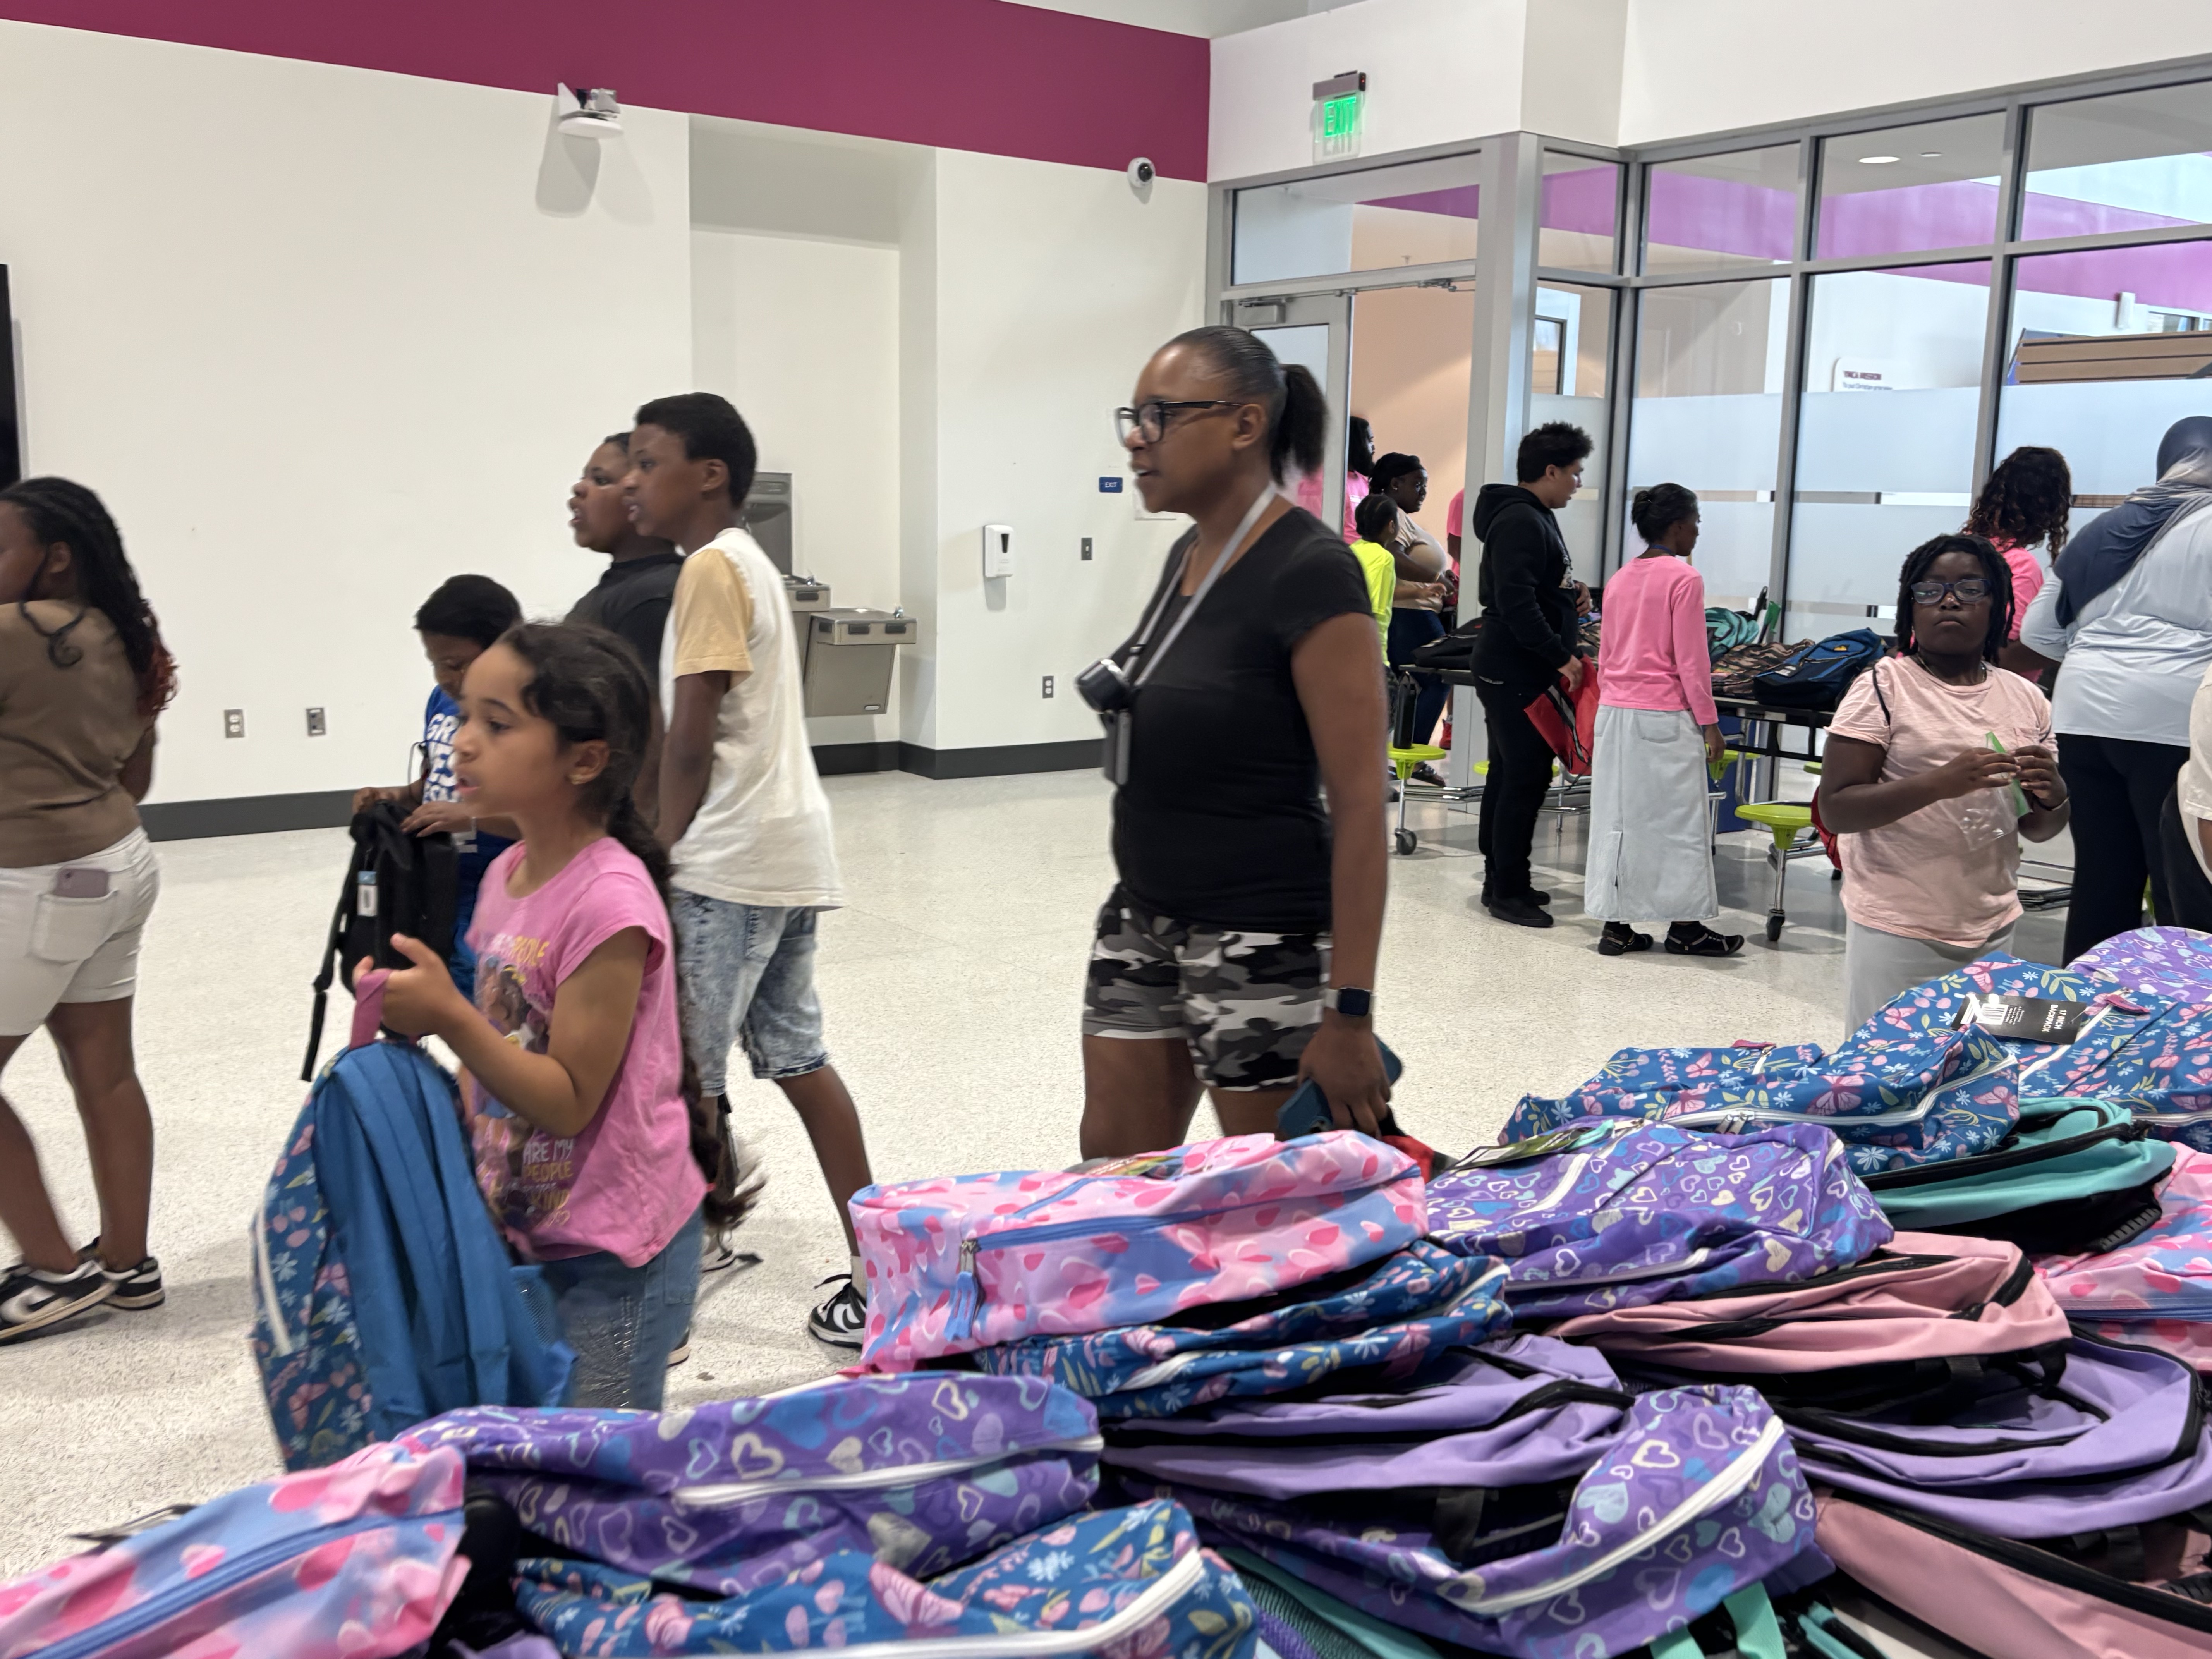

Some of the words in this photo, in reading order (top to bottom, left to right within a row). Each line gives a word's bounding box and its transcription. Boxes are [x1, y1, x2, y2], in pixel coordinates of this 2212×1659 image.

[1324, 96, 1356, 137] EXIT
[2041, 1004, 2058, 1032] BACKPACK
[2054, 1016, 2066, 1029] INCH
[523, 1142, 550, 1164] ARE
[553, 1139, 573, 1161] MY
[524, 1161, 573, 1182] PEOPLE
